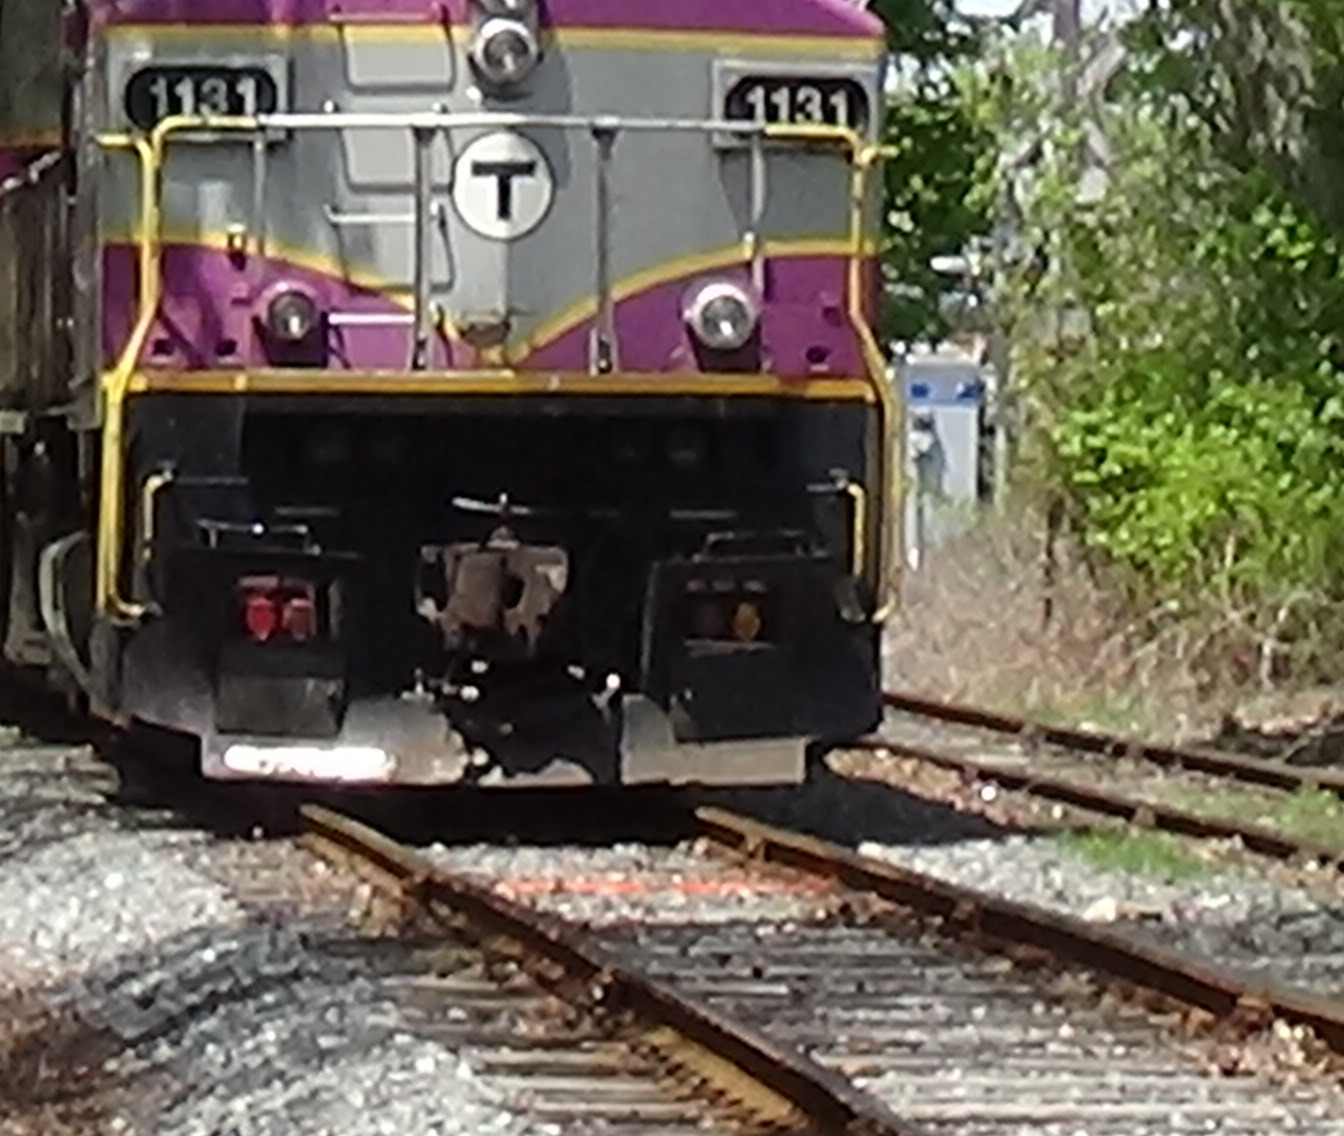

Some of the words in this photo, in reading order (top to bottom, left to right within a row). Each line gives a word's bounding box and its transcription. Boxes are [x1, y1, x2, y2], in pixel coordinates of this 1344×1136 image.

[150, 76, 256, 116] 1131
[746, 85, 848, 126] 1131
[471, 161, 536, 220] T
